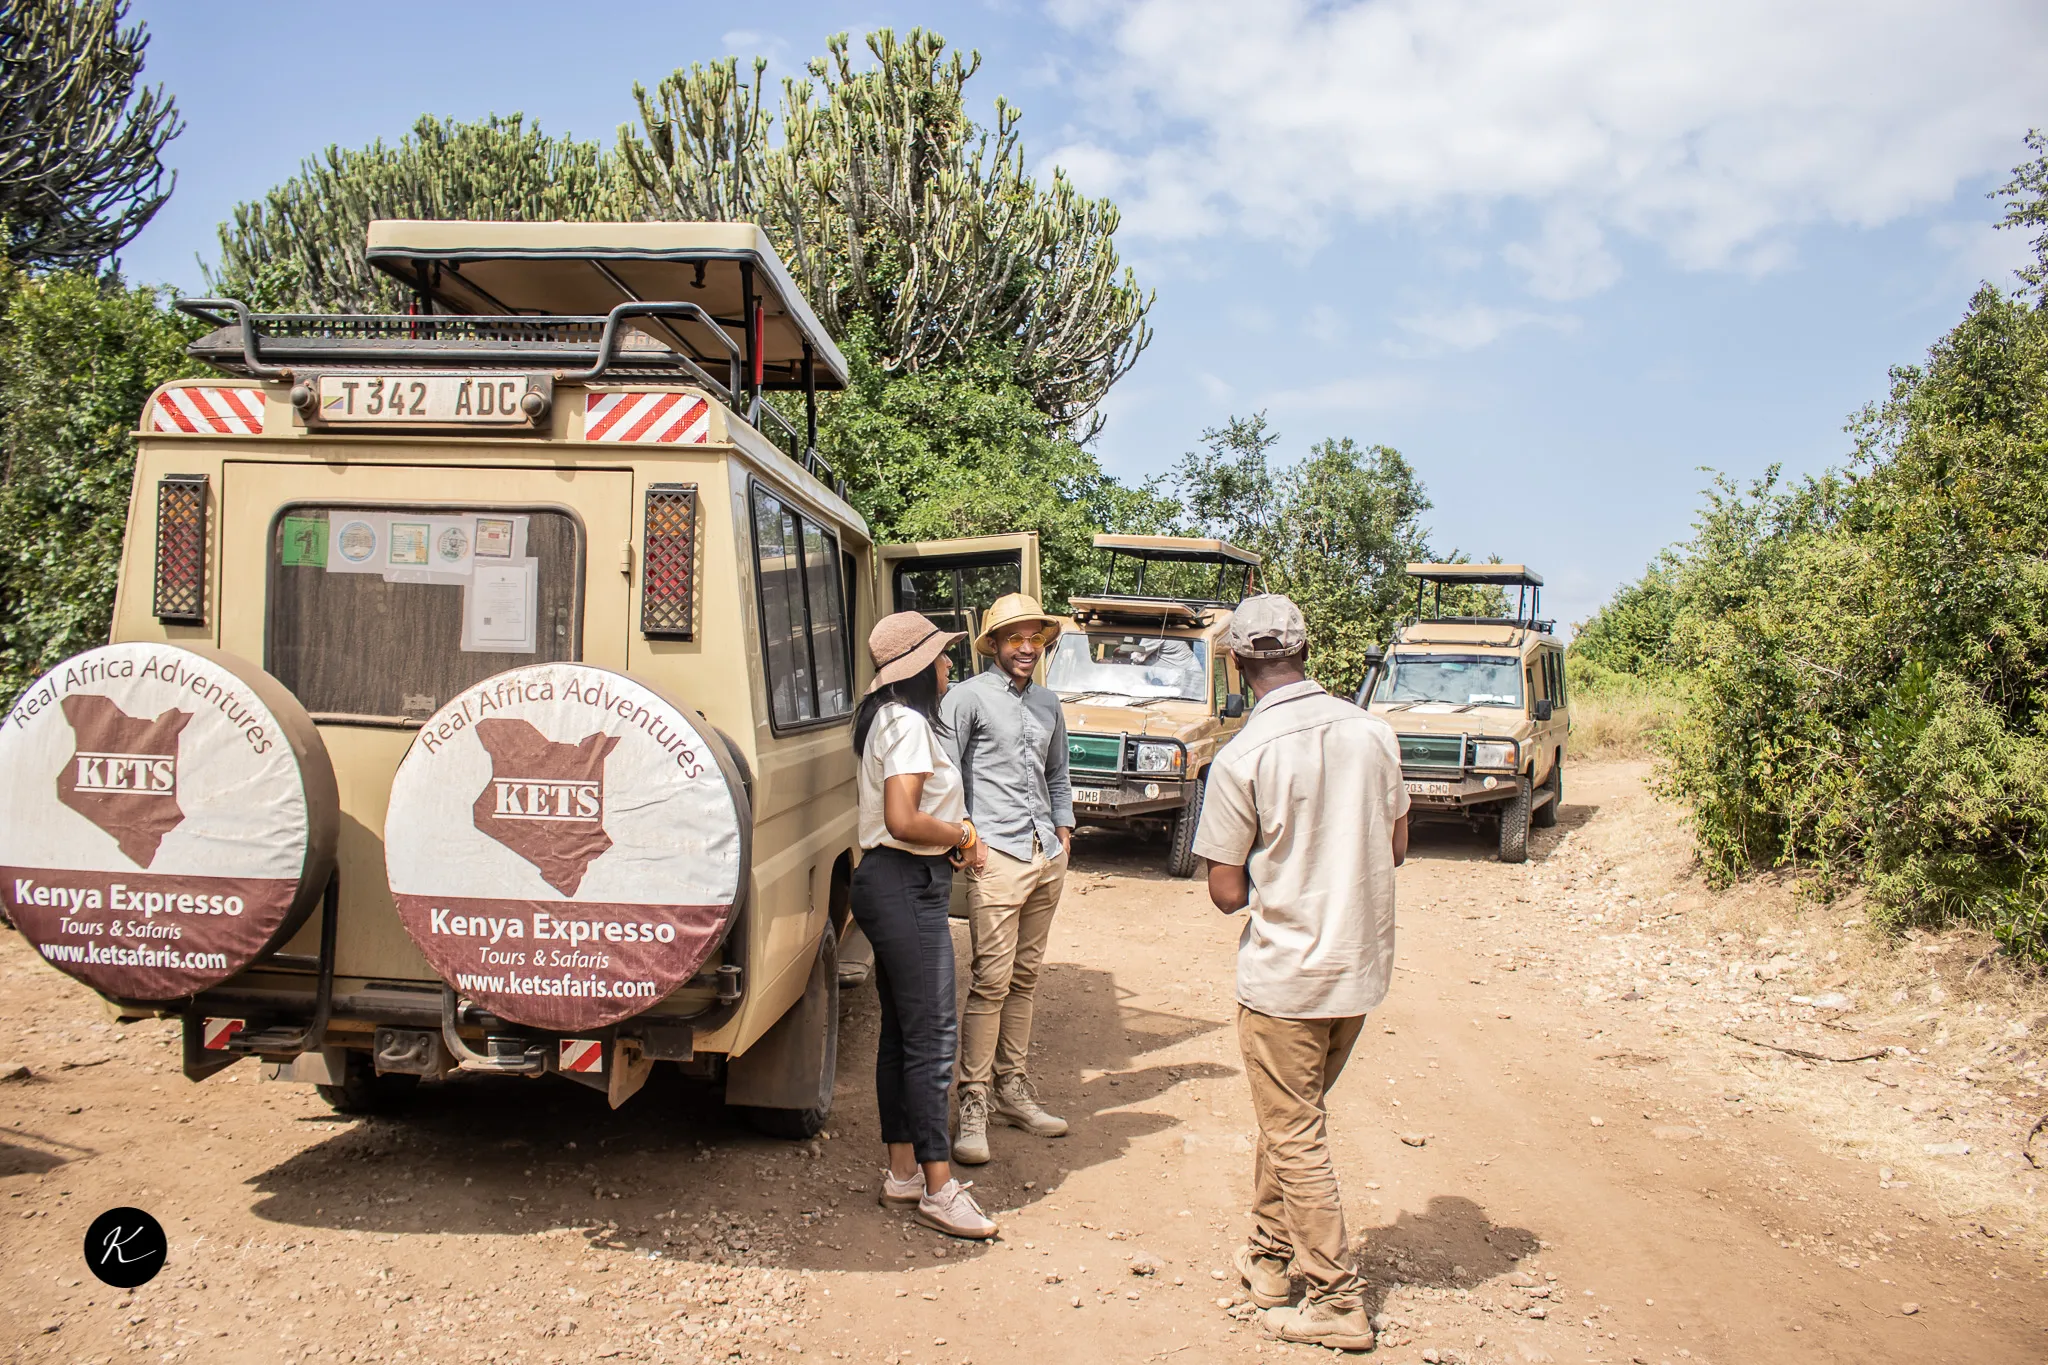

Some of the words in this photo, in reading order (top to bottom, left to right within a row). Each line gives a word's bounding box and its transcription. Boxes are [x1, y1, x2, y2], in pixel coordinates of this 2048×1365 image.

[455, 382, 515, 416] ADC
[13, 678, 58, 729] Real
[65, 657, 134, 692] Africa
[141, 655, 273, 755] Adventures
[421, 701, 473, 755] Real
[480, 680, 554, 716] Africa
[563, 678, 705, 780] Adventures
[75, 757, 175, 792] KETS
[494, 782, 600, 818] KETS
[1077, 790, 1098, 802] DMB
[15, 878, 103, 915] Kenya
[110, 883, 244, 918] Expresso
[59, 917, 104, 936] Tours
[109, 919, 122, 936] &
[125, 919, 182, 940] Safaris
[430, 908, 524, 945] Kenya
[533, 912, 675, 948] Expresso
[40, 941, 227, 970] www.ketsafaris.com
[478, 946, 526, 966] Tours
[533, 949, 547, 966] &
[550, 948, 610, 969] Safaris
[456, 971, 656, 998] www.ketsafaris.com
